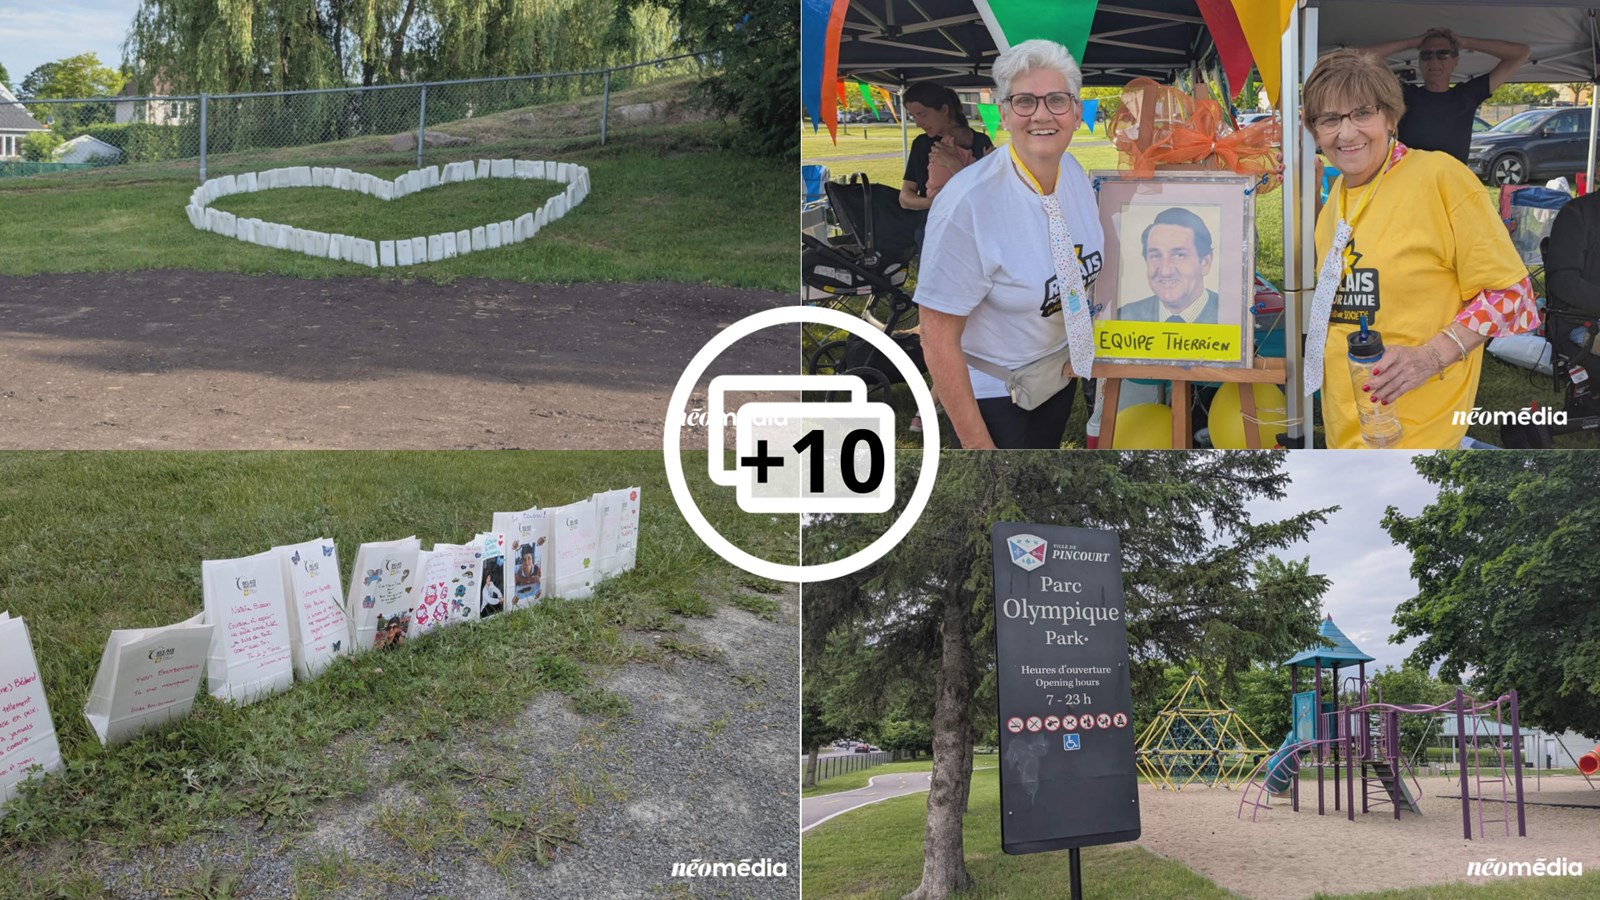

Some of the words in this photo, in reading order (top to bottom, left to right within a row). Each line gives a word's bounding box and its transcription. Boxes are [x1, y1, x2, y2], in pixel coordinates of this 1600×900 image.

[1048, 254, 1101, 299] RAIS
[1337, 272, 1375, 293] LAIS
[1343, 294, 1353, 306] LA
[1354, 294, 1376, 307] VIE
[1052, 549, 1110, 563] PINCOURT
[1040, 576, 1082, 594] Parc
[1003, 598, 1120, 626] Olympique
[1021, 665, 1056, 675] Heures
[1035, 678, 1074, 688] Opening
[1075, 677, 1100, 687] hours
[1046, 694, 1054, 706] 7
[1065, 694, 1080, 705] 23
[1083, 693, 1092, 705] h
